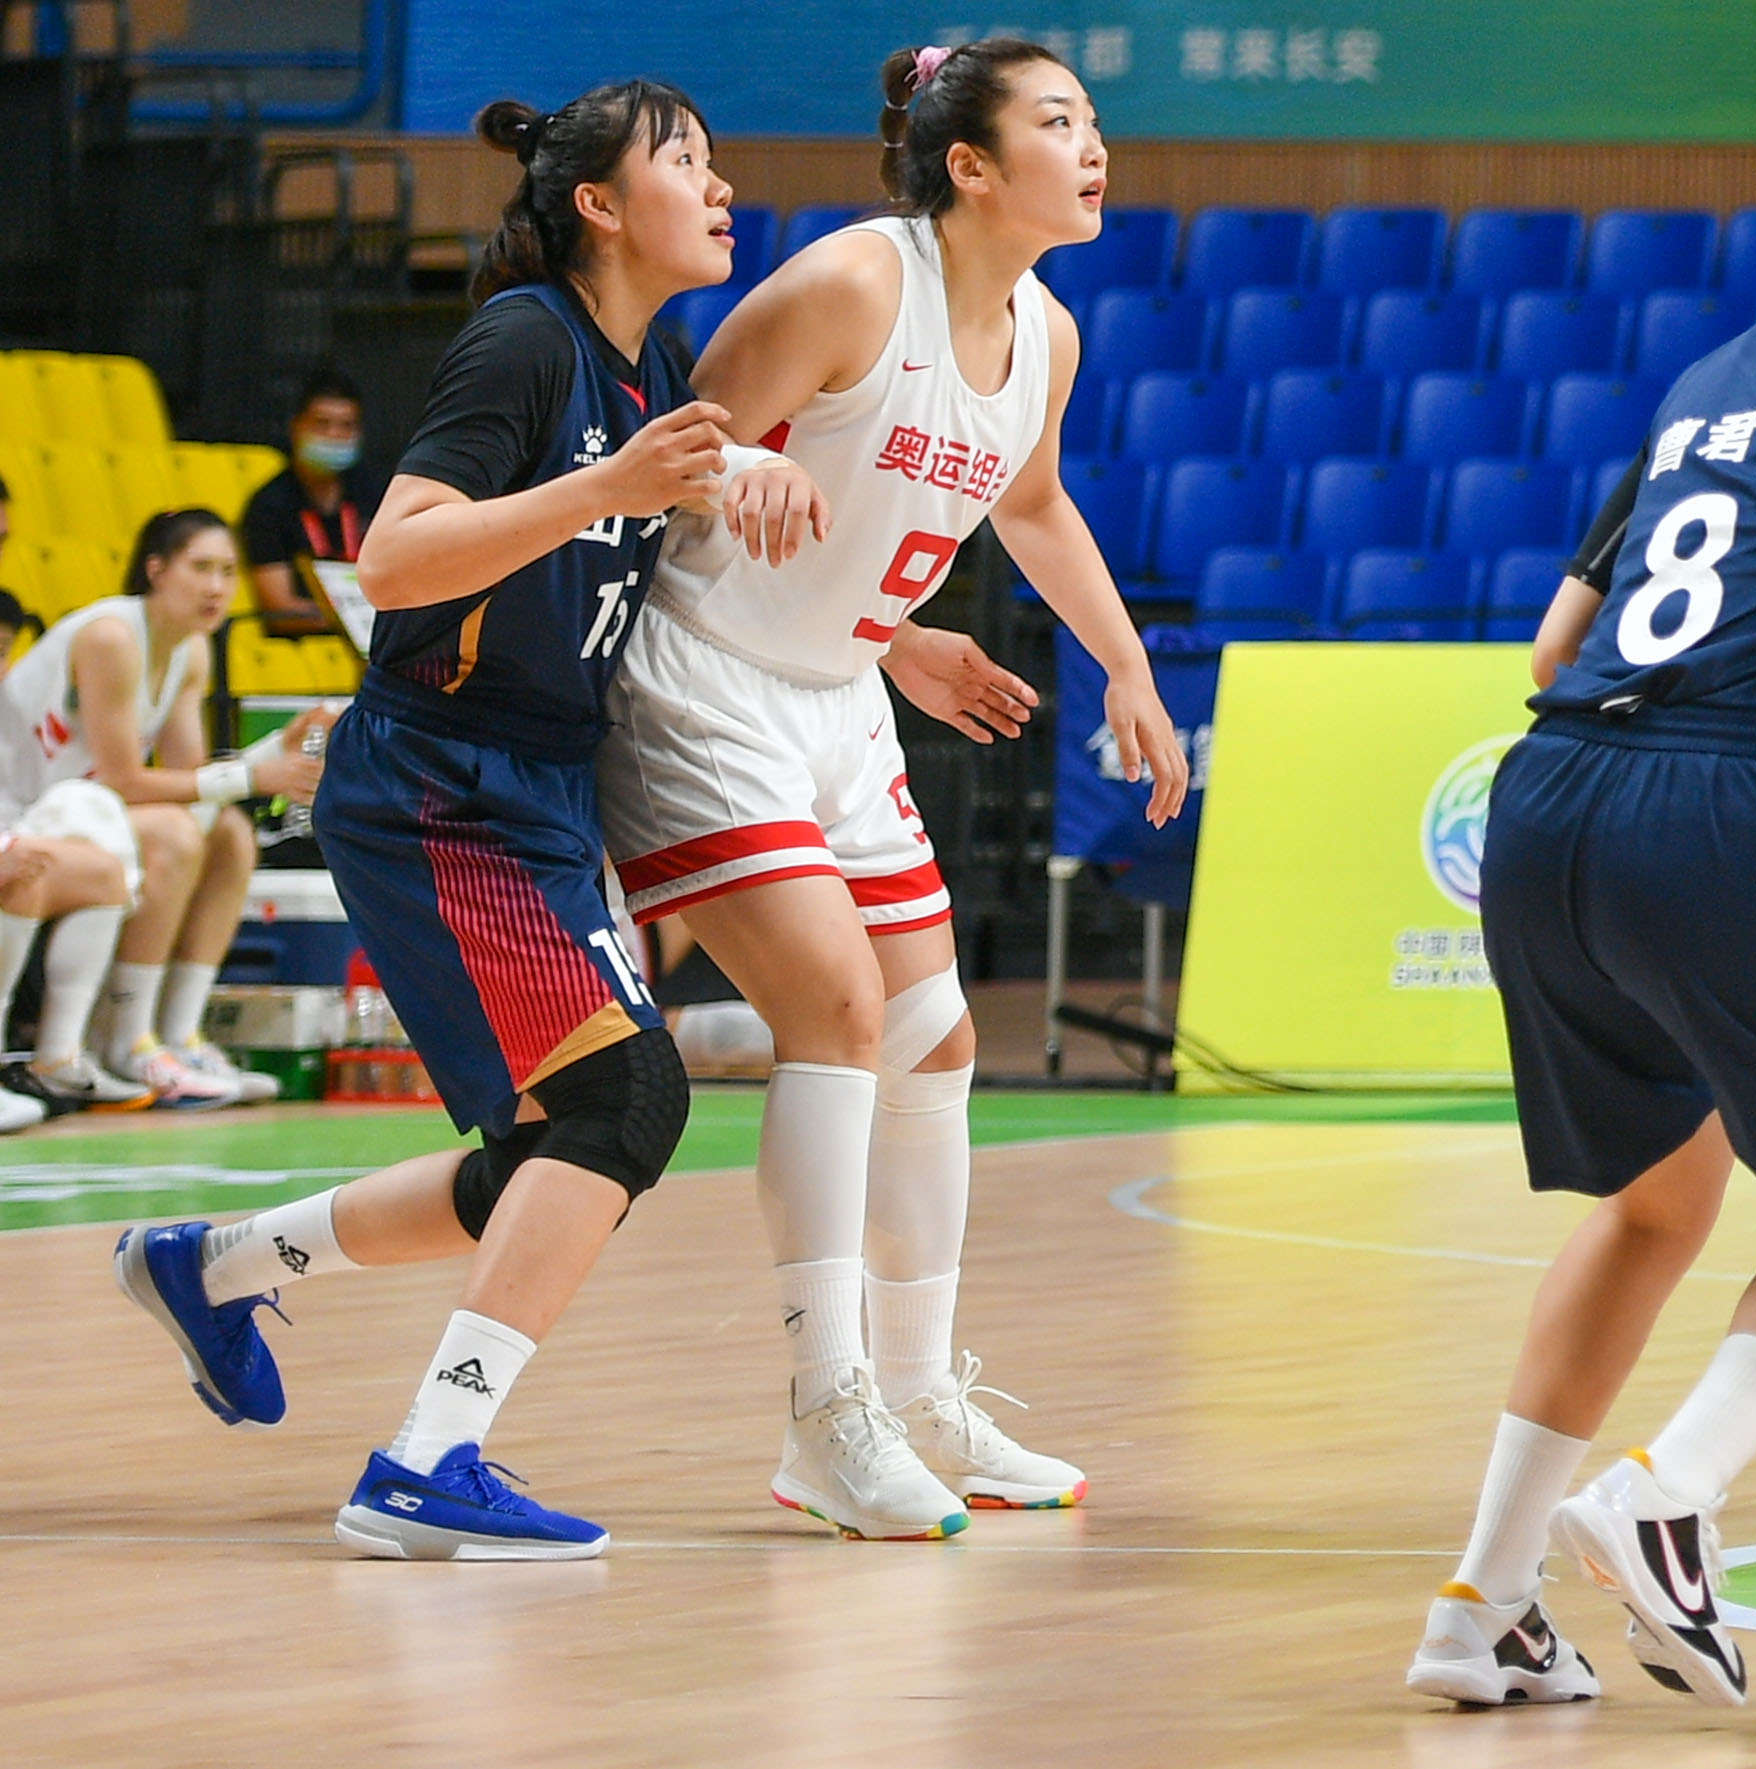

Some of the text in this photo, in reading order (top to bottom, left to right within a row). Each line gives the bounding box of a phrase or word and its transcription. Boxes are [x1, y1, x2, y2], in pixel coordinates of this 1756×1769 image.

[852, 529, 958, 644] 9
[1616, 492, 1739, 667] 8
[436, 1369, 497, 1399] PEAK
